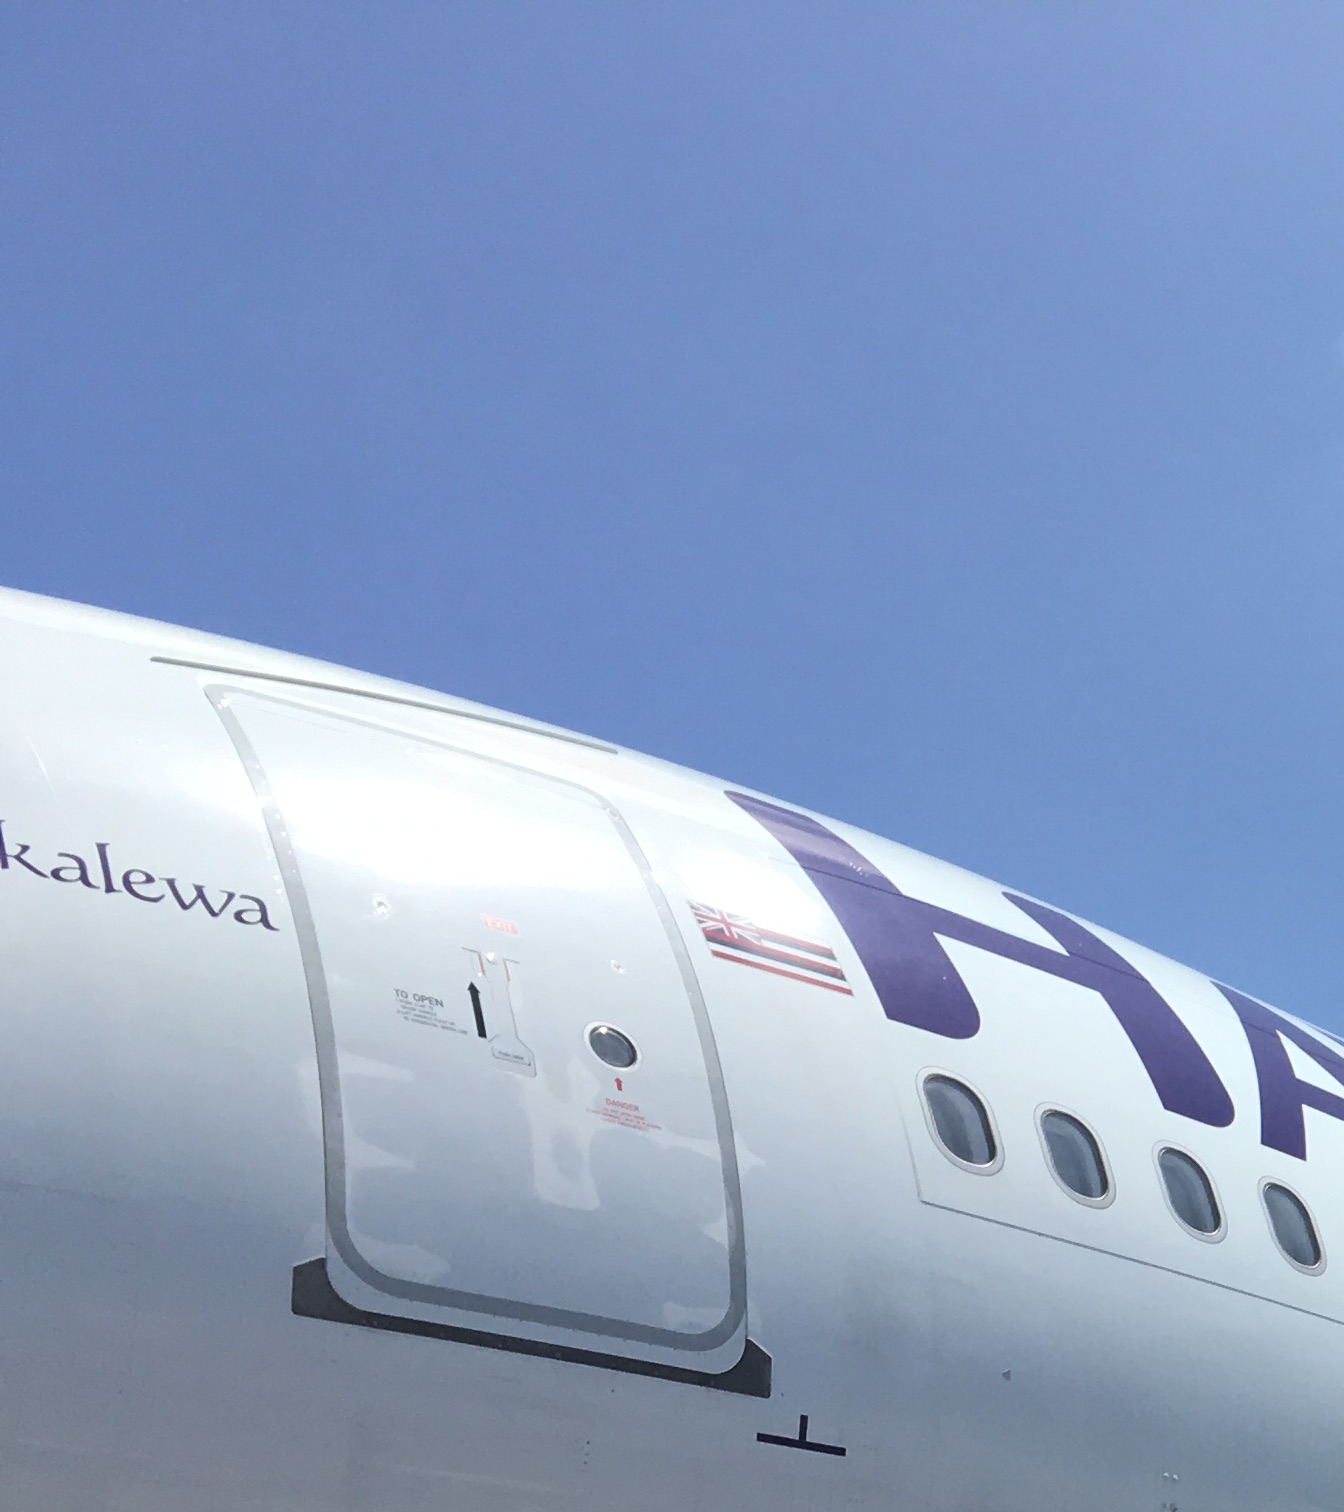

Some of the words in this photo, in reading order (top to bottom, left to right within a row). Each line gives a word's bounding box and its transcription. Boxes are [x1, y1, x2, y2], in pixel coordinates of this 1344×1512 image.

[393, 988, 409, 1000] TO
[412, 993, 444, 1008] OPEN
[605, 1098, 639, 1111] DANGER
